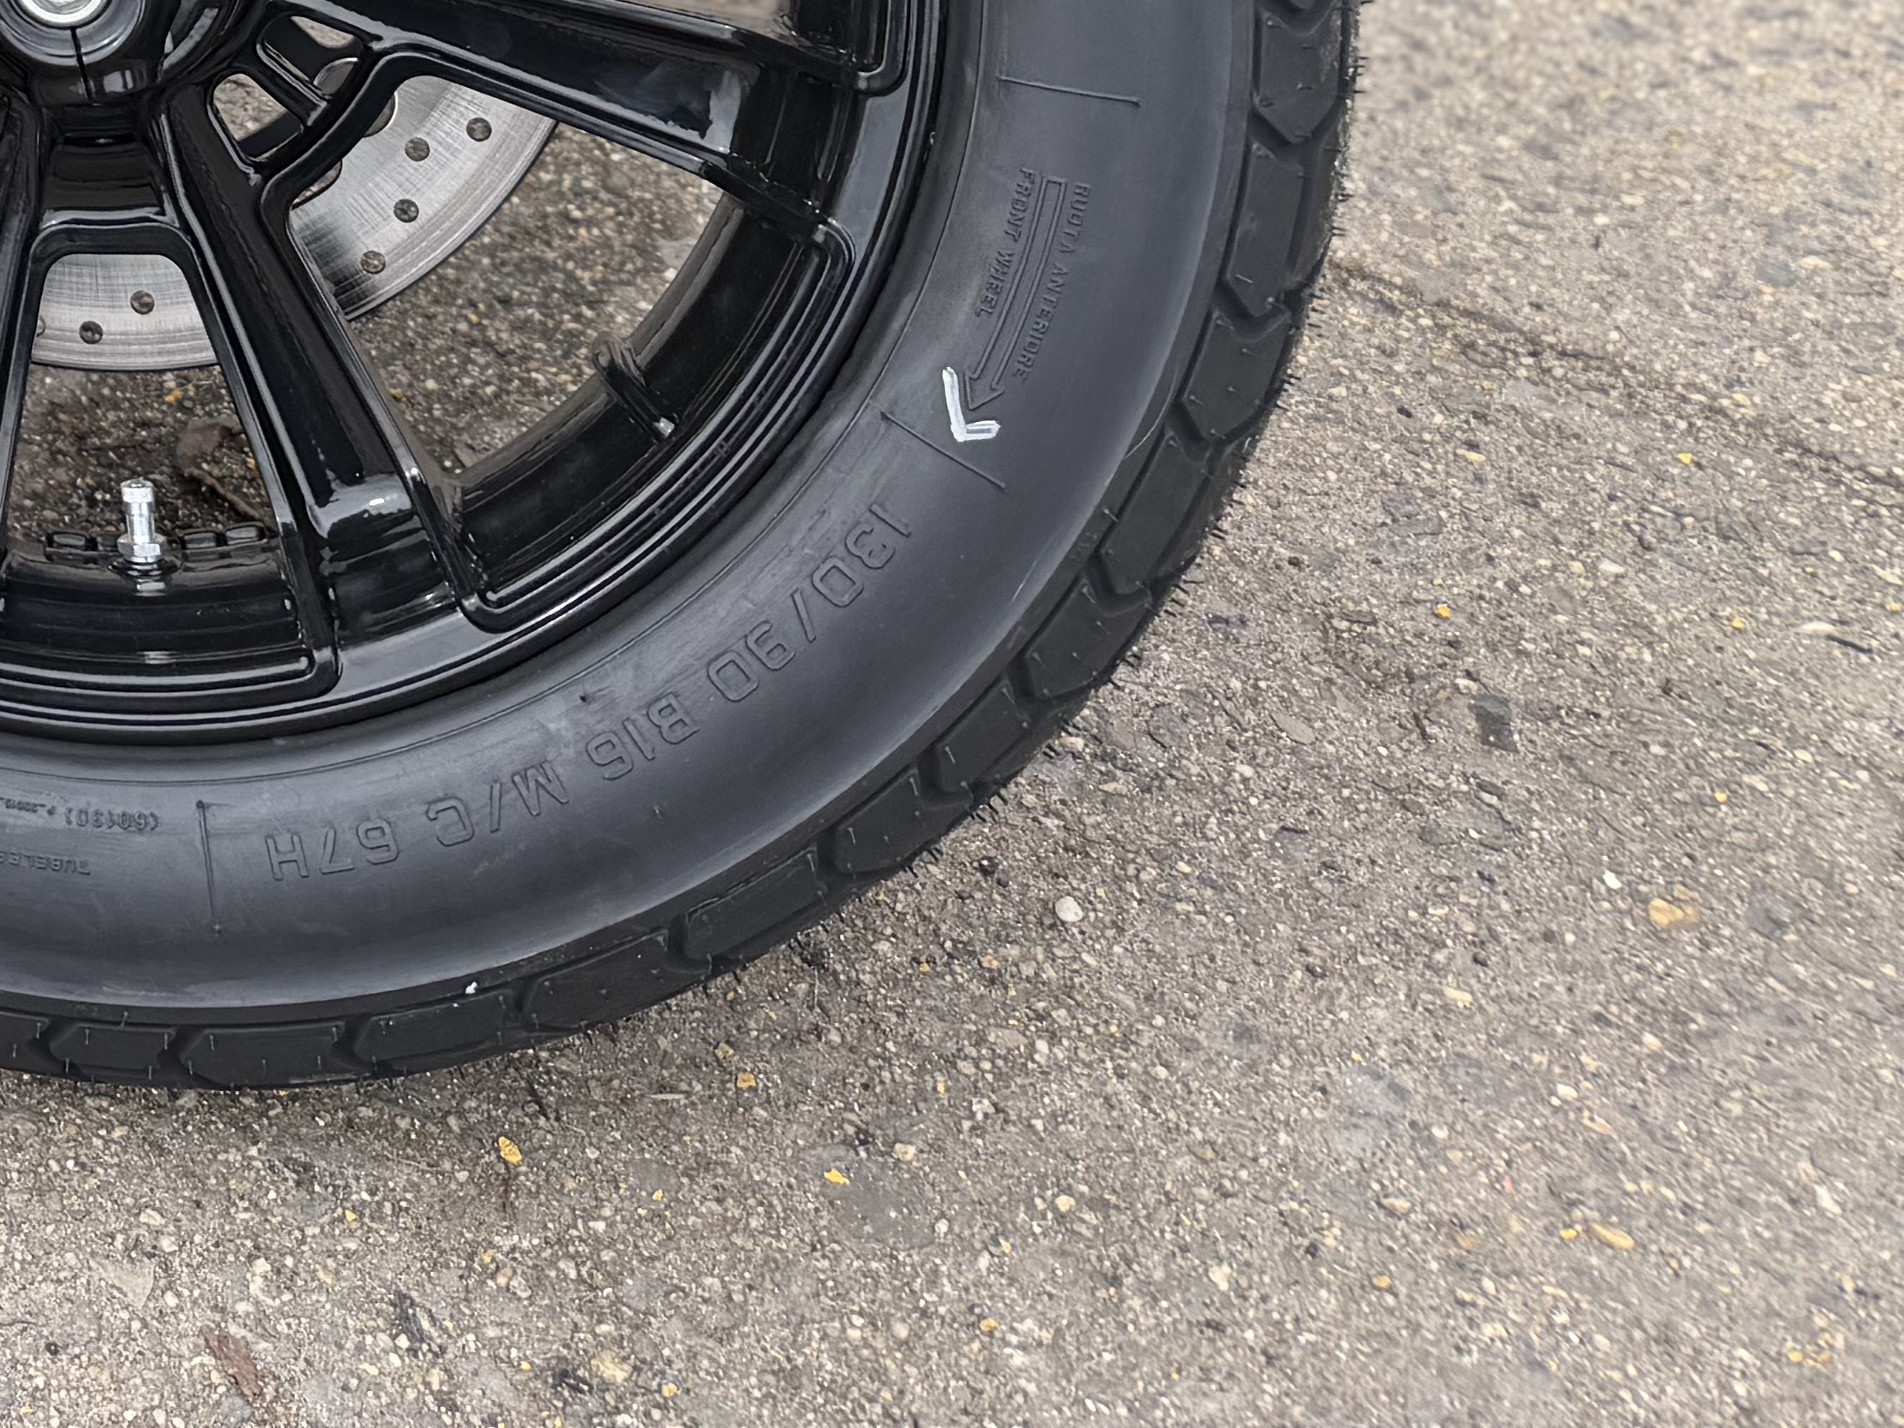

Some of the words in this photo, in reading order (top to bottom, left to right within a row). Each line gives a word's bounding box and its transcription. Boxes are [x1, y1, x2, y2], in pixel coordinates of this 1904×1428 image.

[1004, 166, 1035, 244] FRONT
[1058, 182, 1090, 256] RUOTA
[974, 249, 1014, 318] WHEEL
[1014, 263, 1066, 382] ANTERIORE
[706, 501, 913, 705] 130/90
[586, 702, 698, 783] B16
[424, 756, 569, 849] M/C
[265, 815, 401, 884] 67H
